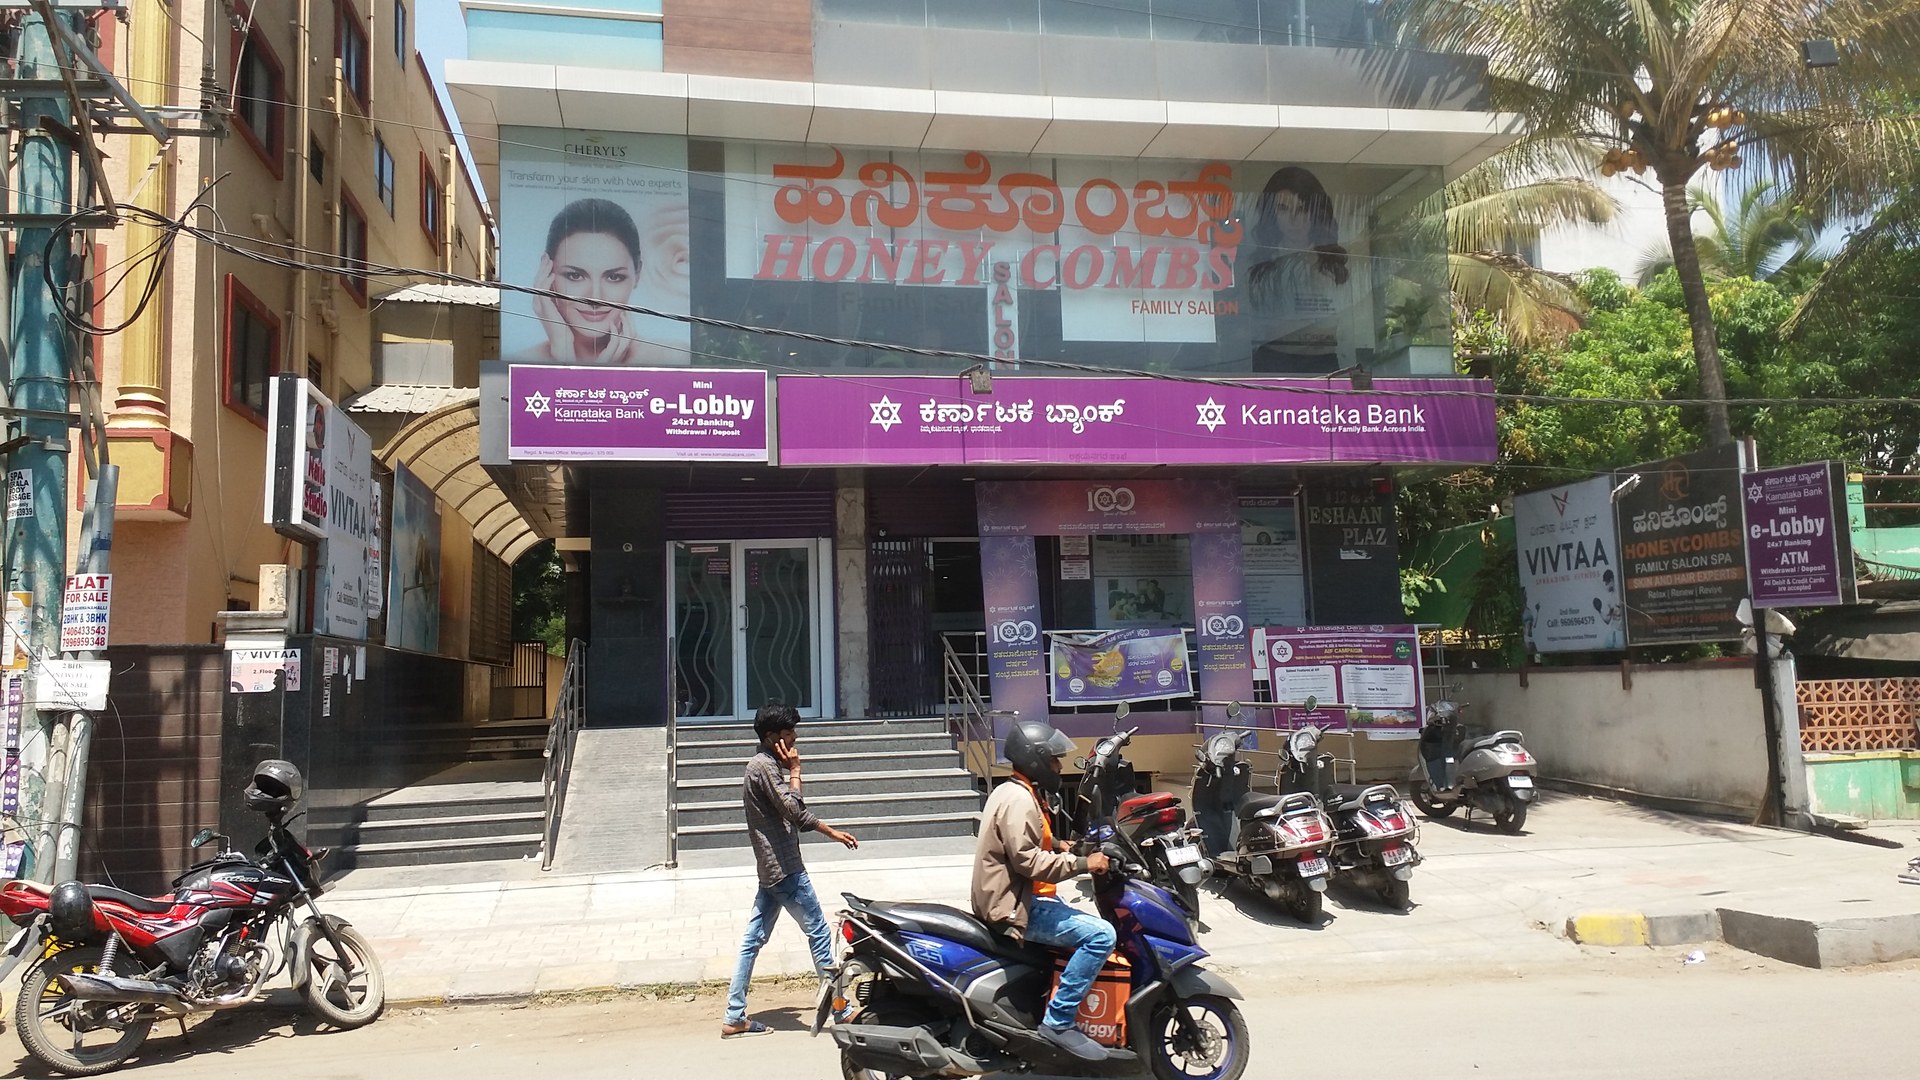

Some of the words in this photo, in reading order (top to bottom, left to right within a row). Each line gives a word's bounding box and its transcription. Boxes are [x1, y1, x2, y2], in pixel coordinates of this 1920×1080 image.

[508, 170, 555, 182] Transform
[558, 175, 579, 186] your
[582, 175, 600, 185] skin
[602, 176, 624, 186] with
[627, 178, 645, 187] two
[648, 179, 682, 190] experts
[754, 234, 995, 287] HONEY
[1020, 245, 1238, 290] COMBS
[1131, 300, 1183, 315] FAMILY
[1187, 300, 1239, 315] SALON
[693, 380, 712, 389] Mini
[554, 407, 612, 419] Karnataka
[615, 408, 645, 419] Bank
[649, 393, 755, 420] e-Lobby
[1242, 404, 1361, 424] Karnataka
[1367, 403, 1426, 424] Bank
[672, 418, 695, 426] 24x7
[697, 418, 734, 428] Banking
[1045, 398, 1126, 434] ಬ್ಯಾಂಕ್
[665, 428, 707, 436] Withdrawal
[713, 429, 741, 437] Deposit
[1321, 425, 1337, 433] Your
[1338, 425, 1361, 434] Family
[1382, 425, 1407, 433] Across
[308, 455, 326, 487] Nails
[304, 484, 328, 519] Studio
[1765, 490, 1802, 502] Karnataka
[1803, 487, 1823, 497] Bank
[330, 485, 367, 542] VIVTAA
[1309, 506, 1382, 525] ESHAAN
[1778, 505, 1797, 515] Mini
[1750, 515, 1825, 539] e-Lobby
[1342, 528, 1387, 546] PLAZ
[1624, 529, 1742, 559] HONEYCOMBS
[1767, 540, 1782, 548] 24x7
[1784, 539, 1812, 547] Banking
[1525, 537, 1609, 576] VIVTAA
[1635, 560, 1670, 574] FAMILY
[1671, 556, 1708, 571] SALON
[1710, 553, 1733, 566] SPA
[1780, 550, 1809, 565] ATM
[1760, 566, 1796, 575] Withdrawal
[1801, 564, 1827, 573] Deposit
[66, 576, 109, 590] FLAT
[1633, 577, 1653, 588] SKIN
[1654, 576, 1673, 587] AND
[1674, 573, 1696, 584] HAIR
[1697, 567, 1738, 582] EXPERTS
[1809, 576, 1826, 584] Cards
[1647, 590, 1666, 599] Relax
[1670, 588, 1694, 598] Renew
[1699, 585, 1723, 595] Revive
[1787, 584, 1812, 592] accepted
[65, 593, 81, 604] FOR
[82, 592, 108, 602] SALE
[63, 614, 79, 624] 2BHK
[86, 612, 107, 623] 3BHK
[63, 625, 106, 636] 7406433543
[250, 650, 298, 659] VIVTAA
